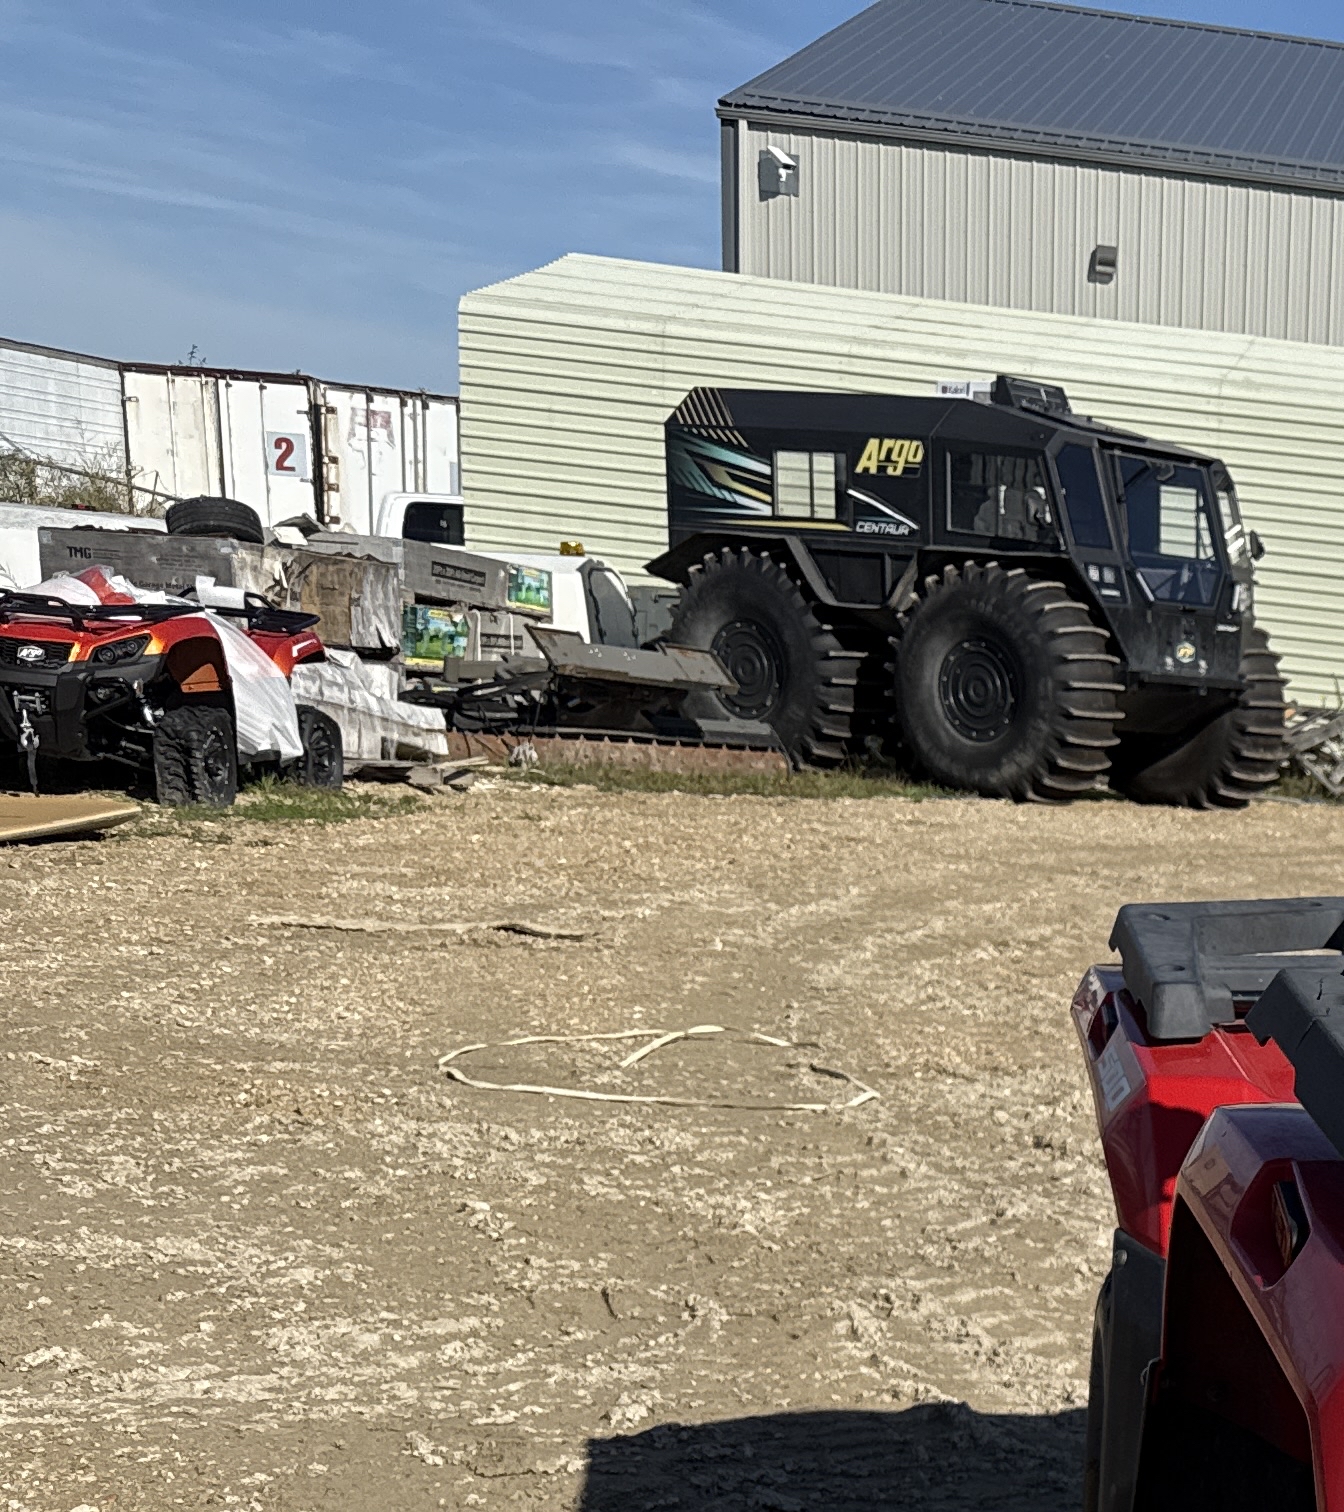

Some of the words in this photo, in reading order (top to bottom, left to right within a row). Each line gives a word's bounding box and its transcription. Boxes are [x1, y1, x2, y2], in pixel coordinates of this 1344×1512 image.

[274, 437, 296, 472] 2
[854, 437, 925, 476] Argo
[856, 521, 910, 535] CENTAUR
[67, 546, 91, 559] TMG
